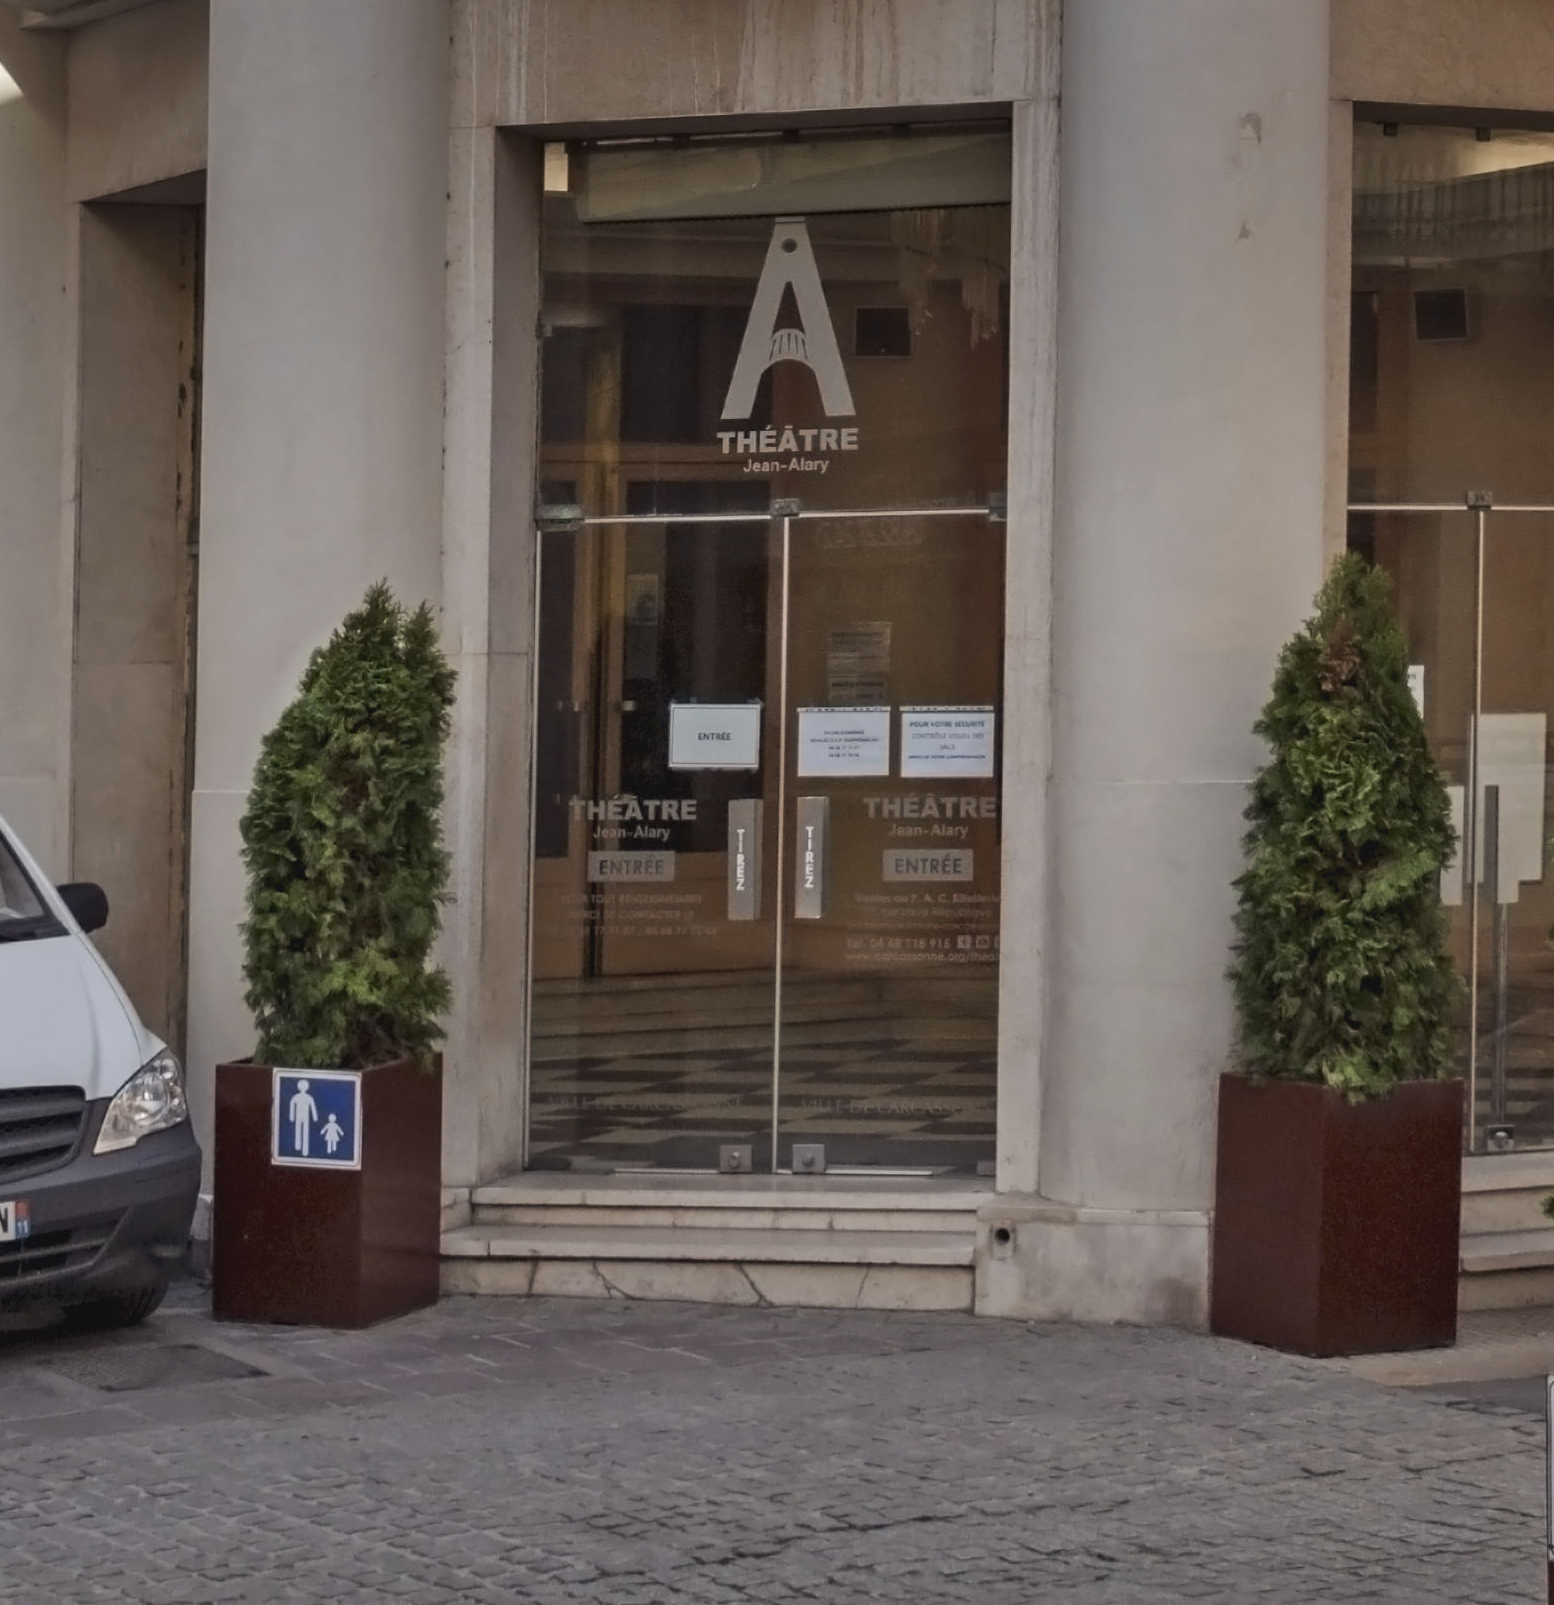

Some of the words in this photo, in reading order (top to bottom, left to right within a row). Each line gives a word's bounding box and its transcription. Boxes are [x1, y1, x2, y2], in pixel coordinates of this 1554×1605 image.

[716, 425, 859, 454] THÉÂTRE
[743, 459, 830, 475] Jean-Alary
[697, 731, 732, 741] ENTRÉE
[593, 826, 671, 842] Jean-Alary
[888, 825, 969, 839] Jean-Alary
[598, 855, 665, 876] ENTRÉE
[735, 828, 745, 891] TIREZ
[804, 825, 815, 889] TIREZ
[894, 854, 963, 875] ENTRÉE
